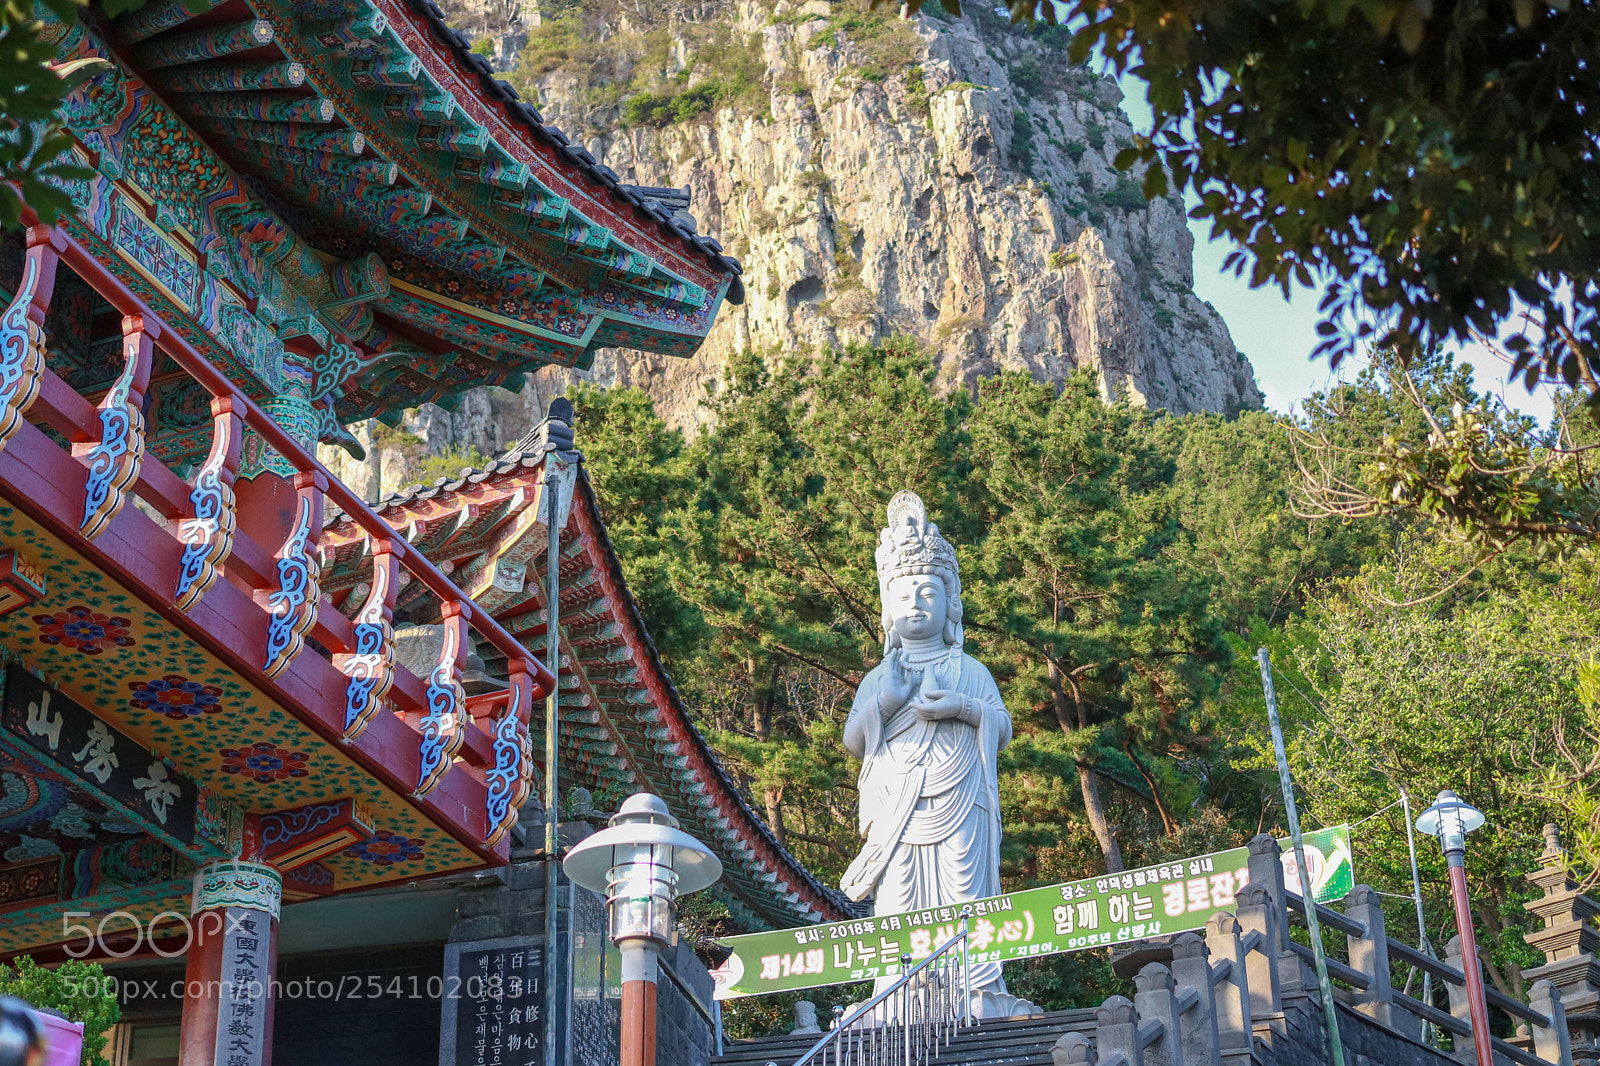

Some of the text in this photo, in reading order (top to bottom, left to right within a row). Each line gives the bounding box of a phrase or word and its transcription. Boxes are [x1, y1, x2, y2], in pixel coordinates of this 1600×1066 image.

[1060, 857, 1214, 901] 장소: 안덕생활체육관 실내
[760, 948, 824, 980] 제14회
[832, 935, 900, 969] 나누는
[1052, 899, 1099, 936] 함께
[1107, 891, 1153, 924] 하는
[794, 897, 1013, 944] 일시: 2018年 4月 14日(토) 오전11시
[850, 966, 880, 980] 국가
[1068, 932, 1111, 948] 90주년
[1116, 921, 1161, 940] 산방사
